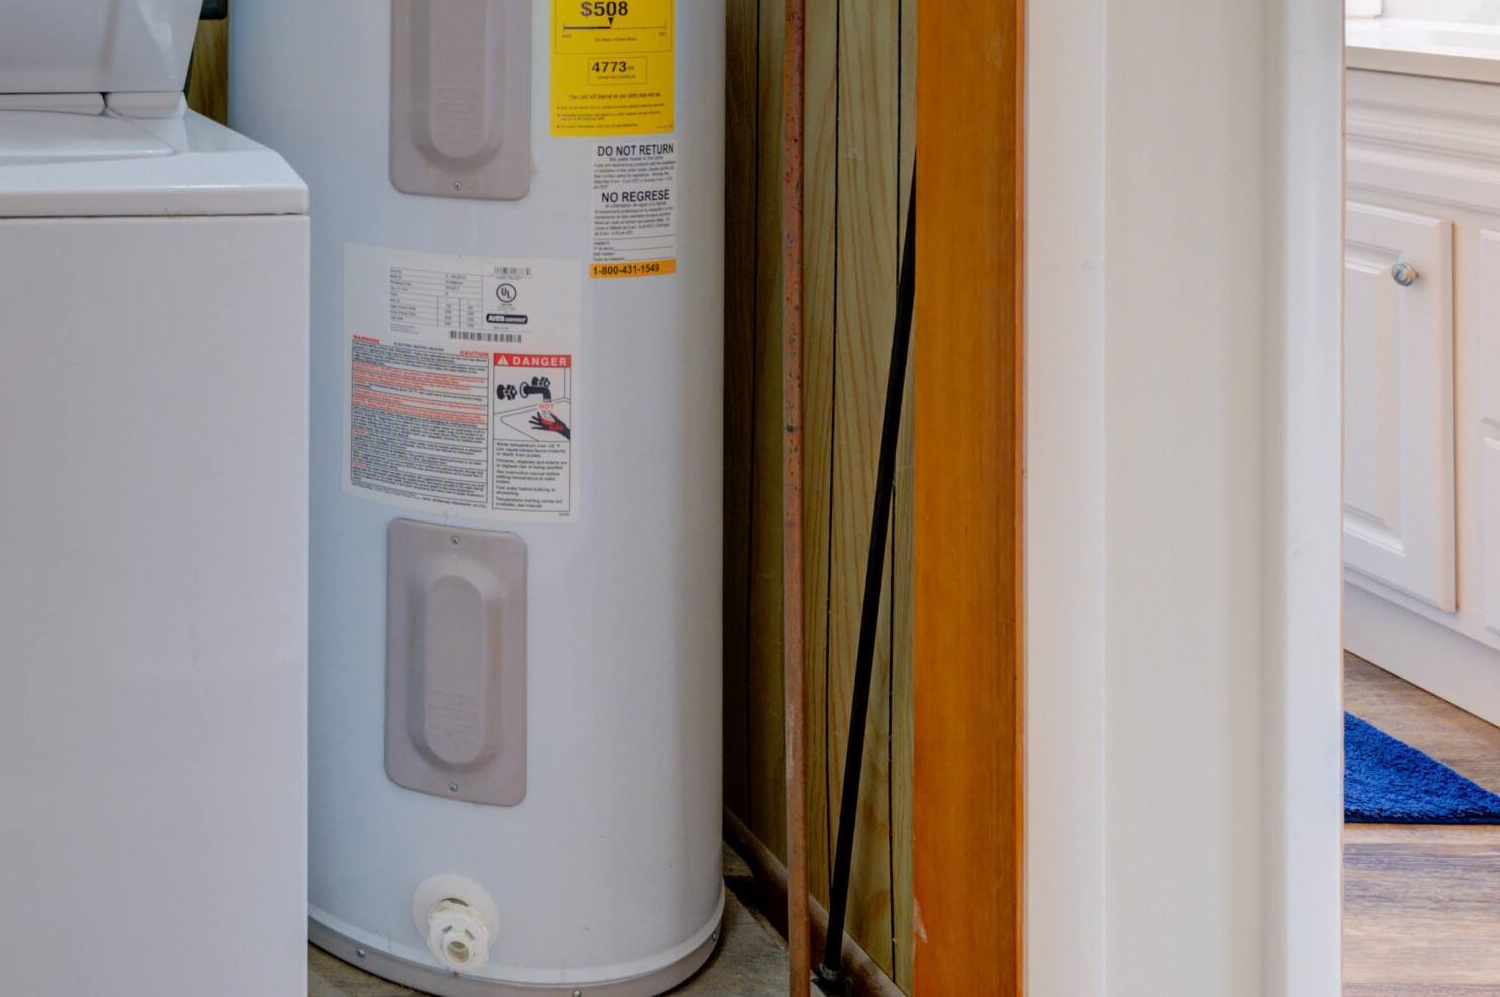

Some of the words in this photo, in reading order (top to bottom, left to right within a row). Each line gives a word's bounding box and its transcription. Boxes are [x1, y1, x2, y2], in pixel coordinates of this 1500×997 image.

[581, 1, 628, 18] $508
[592, 61, 627, 73] 4773
[598, 146, 613, 156] DO
[616, 145, 636, 156] NOT
[639, 143, 674, 155] RETURN
[602, 192, 618, 202] NO
[622, 189, 670, 202] REGRESE
[513, 356, 566, 366] DANGER
